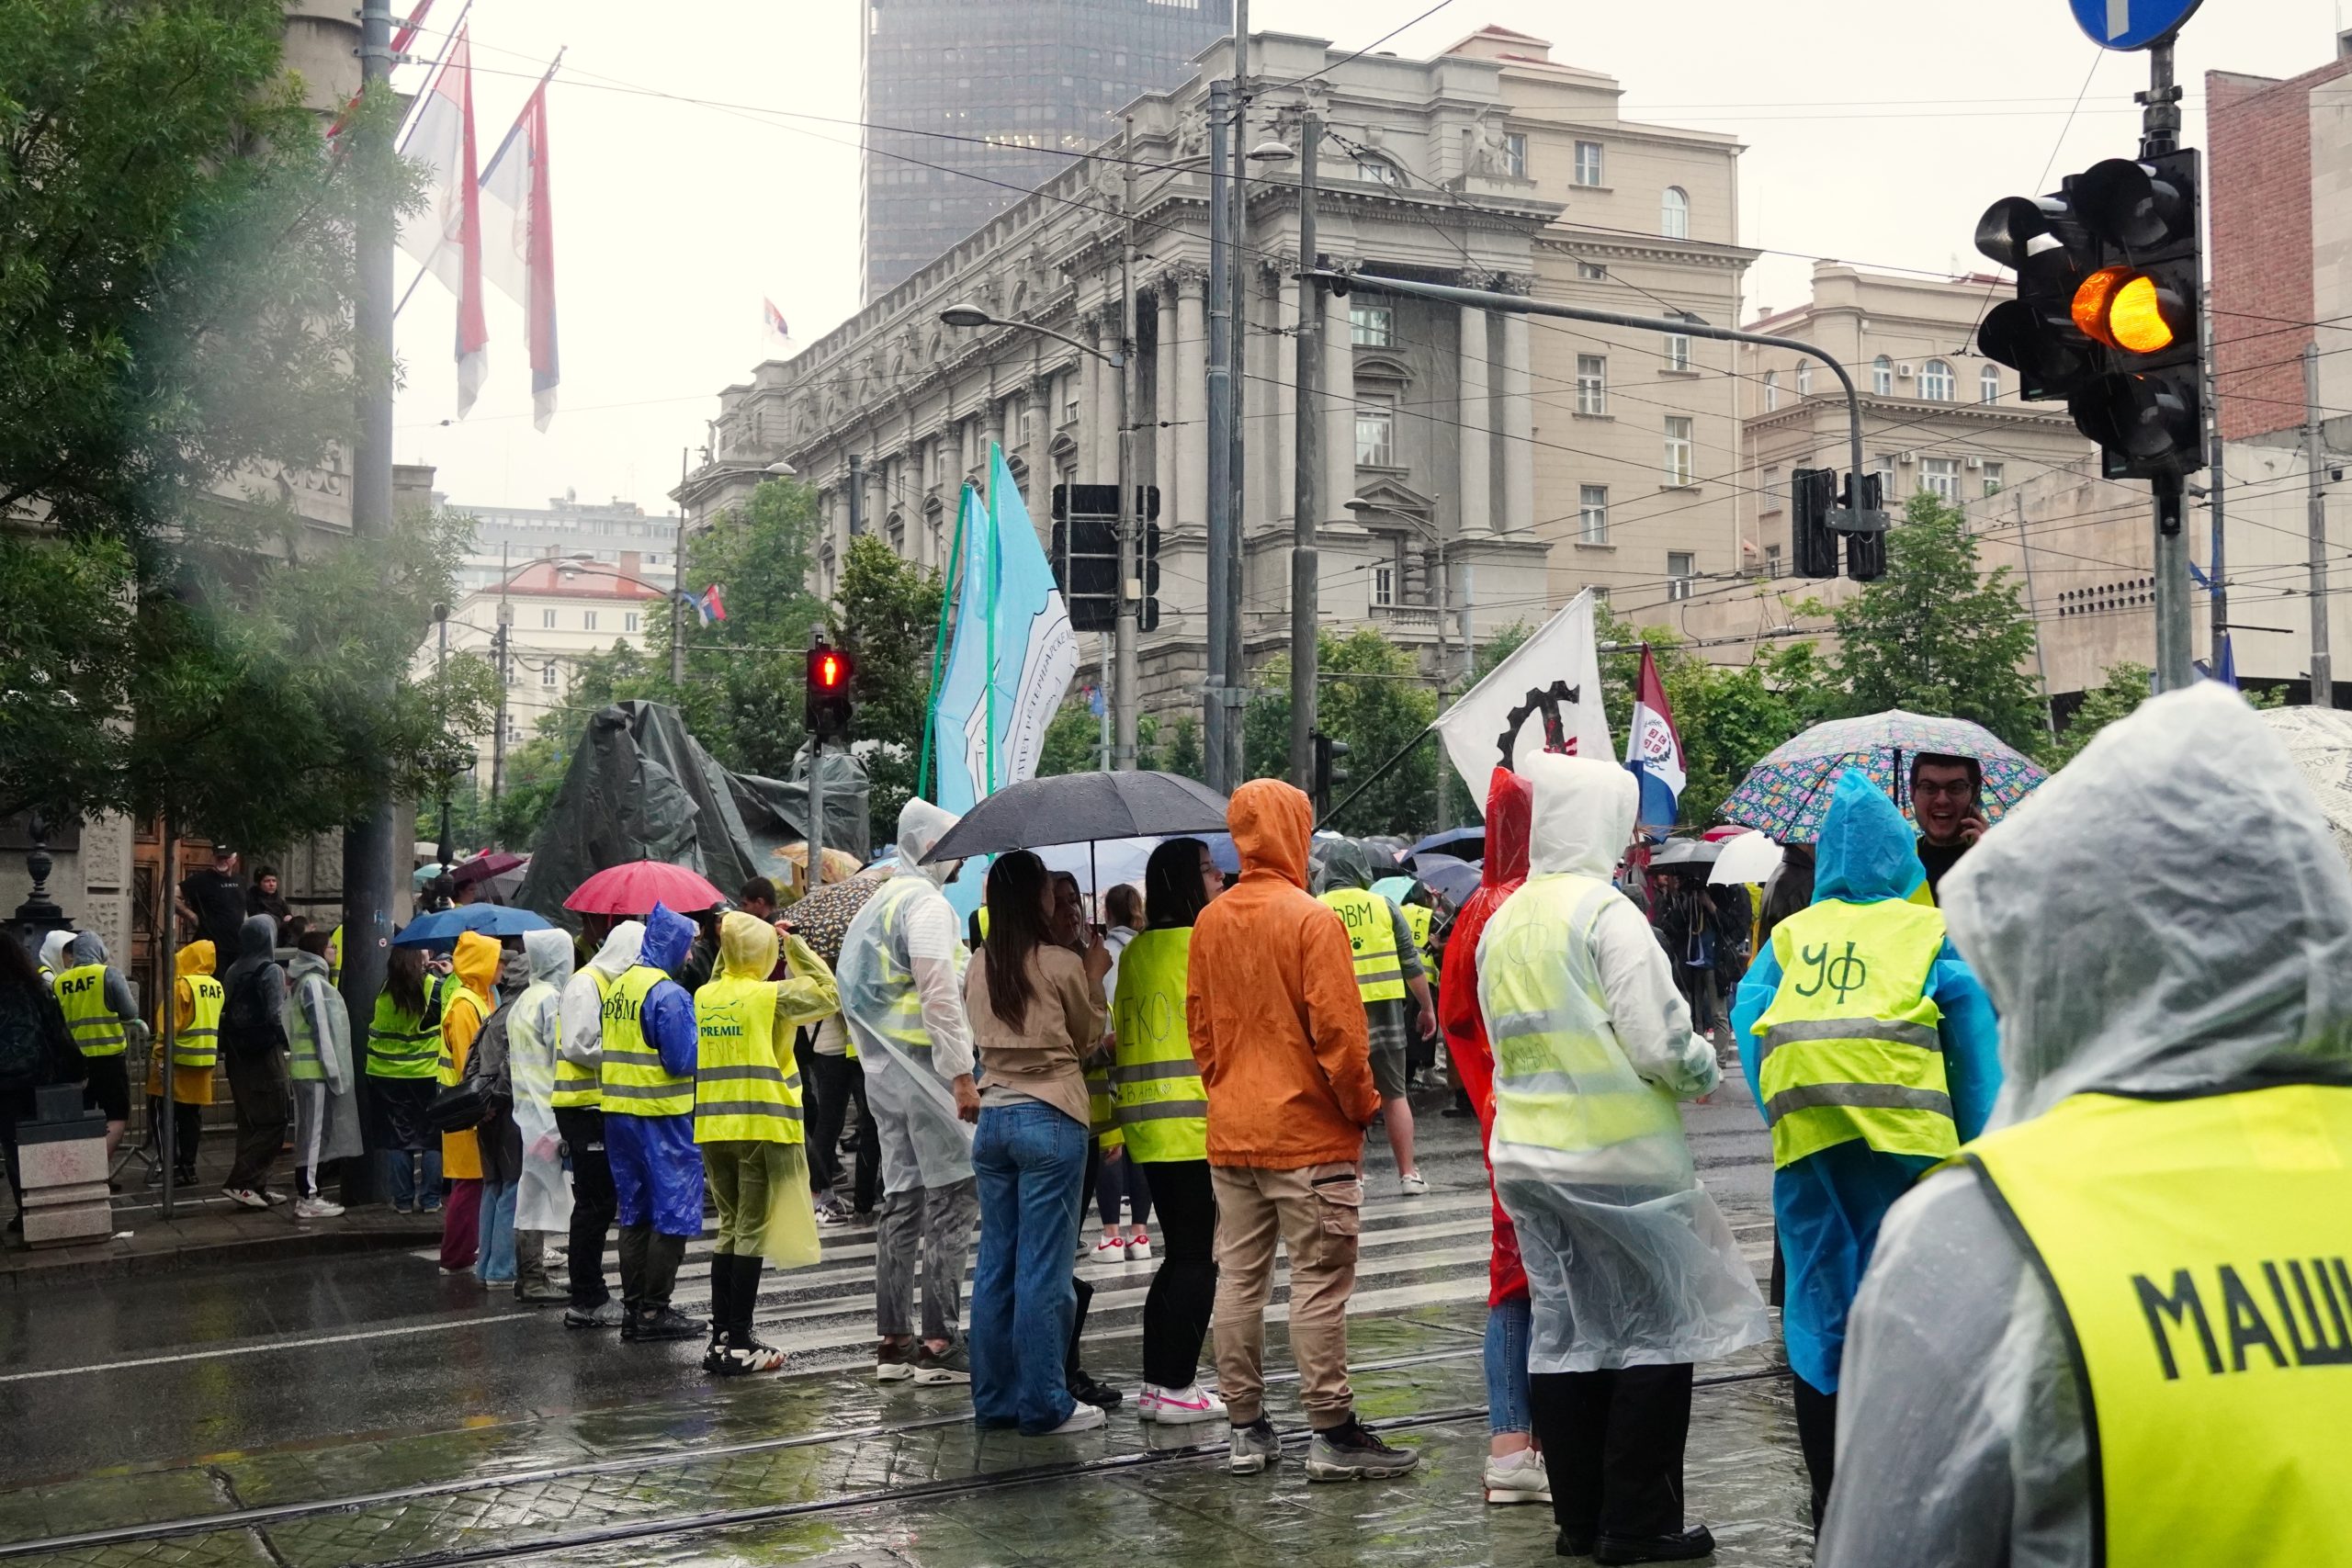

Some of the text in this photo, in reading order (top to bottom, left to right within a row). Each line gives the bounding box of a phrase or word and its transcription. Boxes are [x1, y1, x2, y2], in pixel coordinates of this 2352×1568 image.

[1795, 942, 1866, 1004] УФ
[62, 976, 96, 995] RAF
[199, 984, 222, 998] RAF
[700, 1025, 743, 1037] PREMIL
